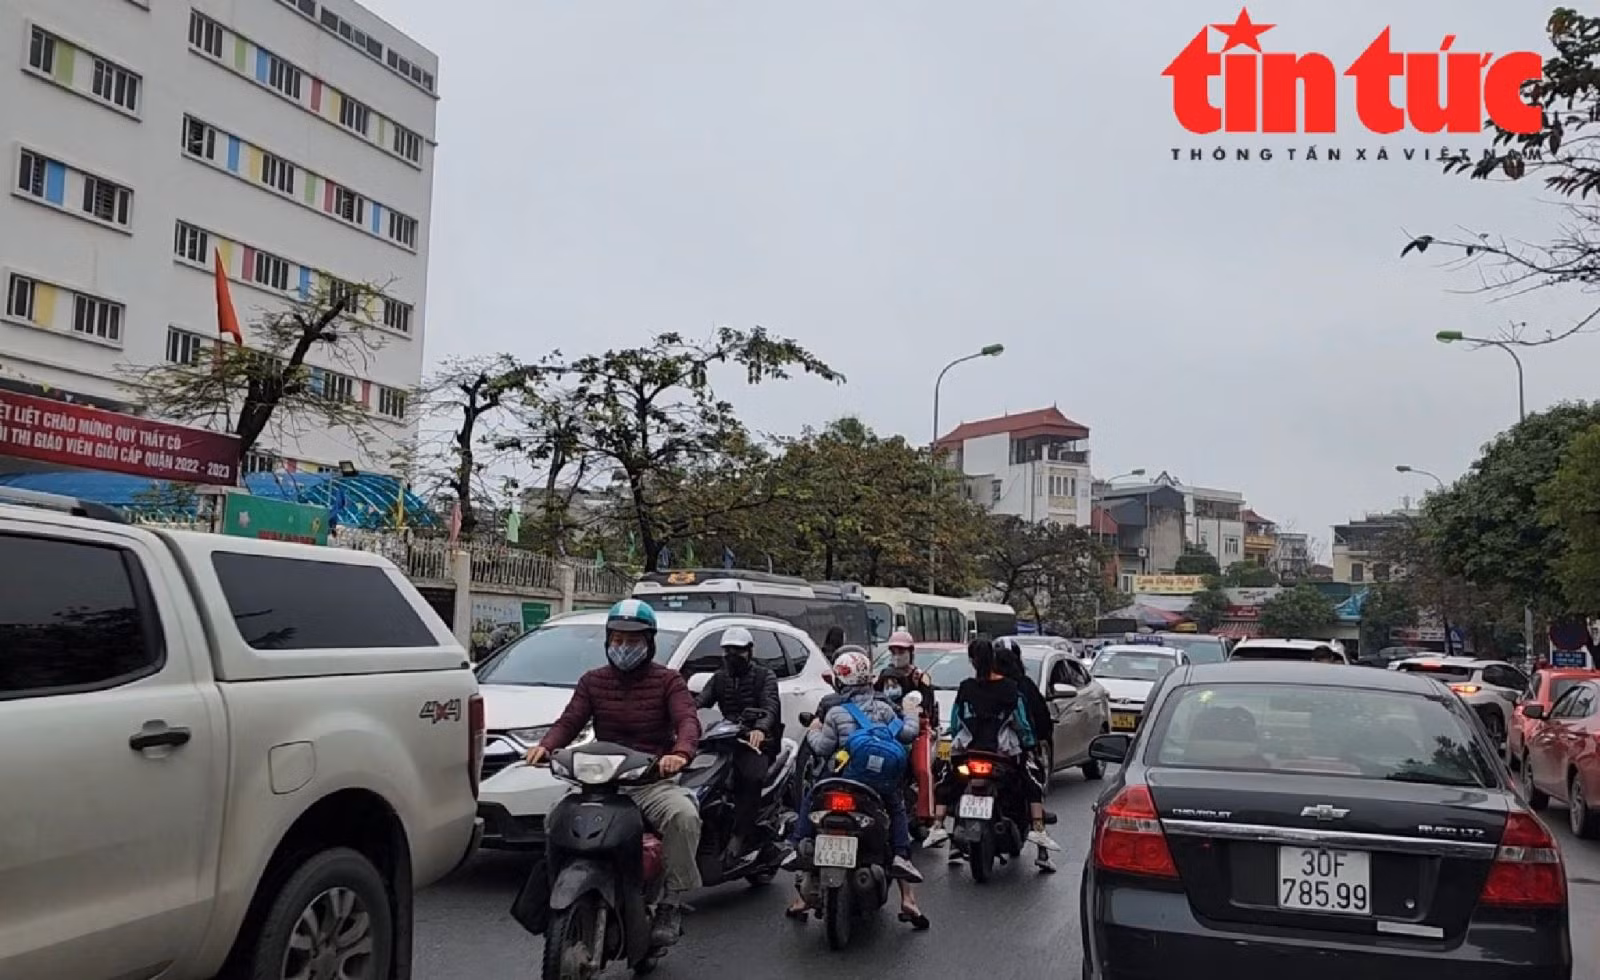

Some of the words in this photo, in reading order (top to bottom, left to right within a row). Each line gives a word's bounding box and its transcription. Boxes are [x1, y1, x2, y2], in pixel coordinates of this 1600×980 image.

[15, 405, 41, 427] LIỆT
[43, 411, 76, 432] CHÀO
[78, 418, 113, 439] MỪNG
[115, 425, 136, 442] QUÝ
[168, 434, 182, 450] CÔ
[11, 428, 31, 446] THI
[34, 432, 63, 452] GIÁO
[66, 437, 93, 456] VIÊN
[120, 444, 142, 464] CẤP
[145, 450, 173, 471] QUẬN
[174, 457, 199, 473] 2022
[207, 462, 230, 478] 2023
[1301, 849, 1348, 878] 30F
[1282, 878, 1367, 910] 785.99
